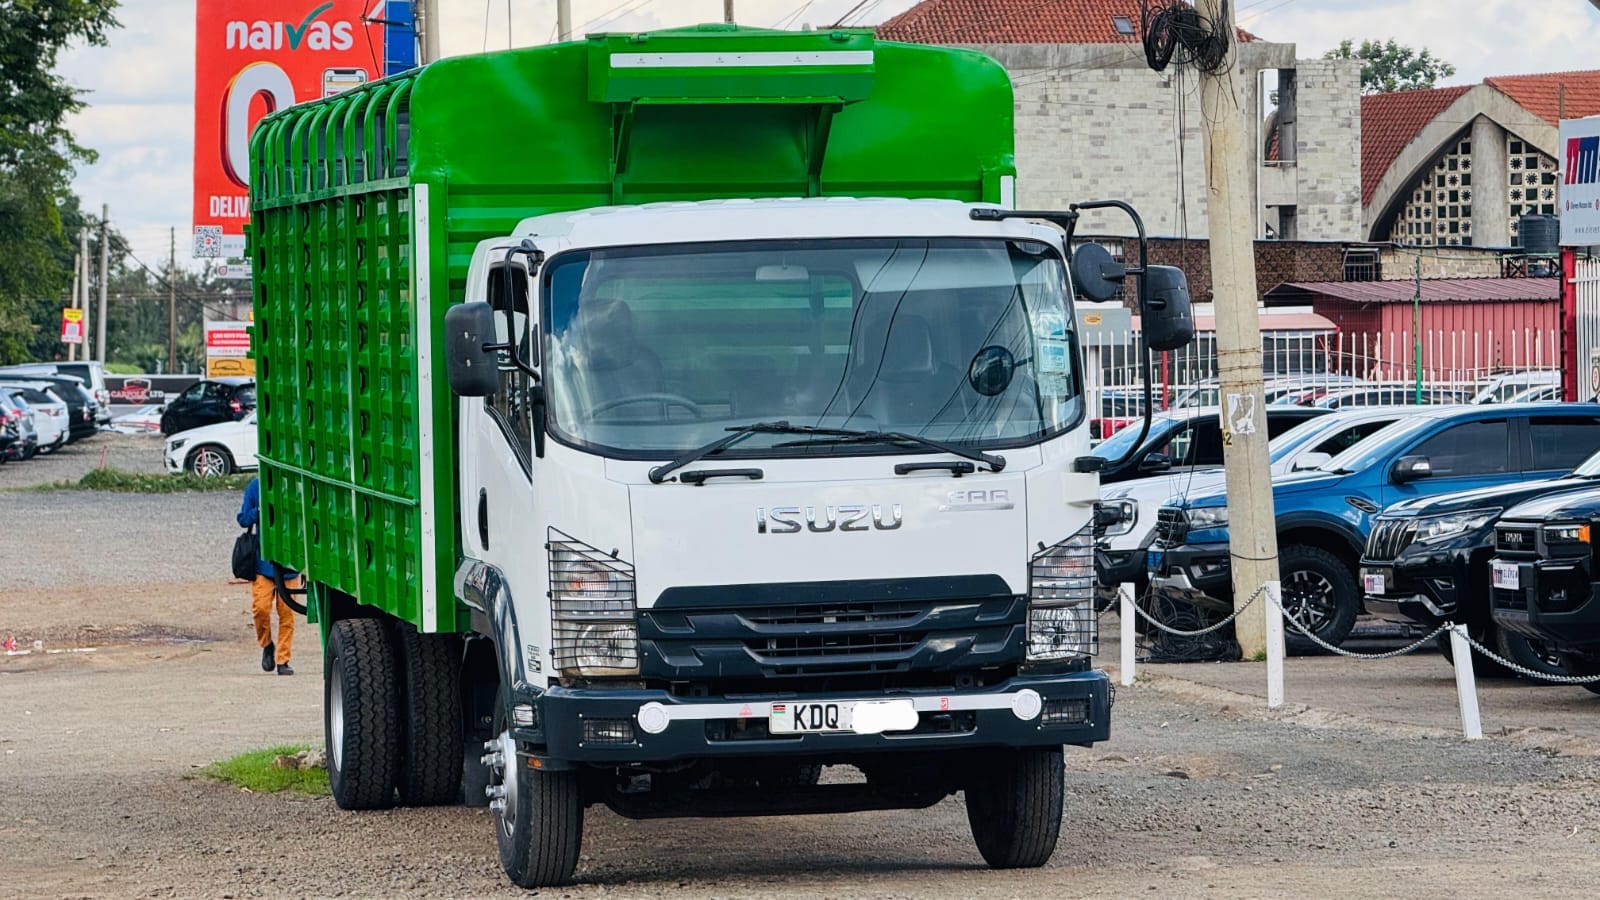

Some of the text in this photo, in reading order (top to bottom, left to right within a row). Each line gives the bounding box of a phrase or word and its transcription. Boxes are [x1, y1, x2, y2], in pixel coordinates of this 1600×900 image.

[226, 3, 353, 50] naivas
[757, 504, 902, 534] ISUZU
[794, 703, 839, 731] KDQ
